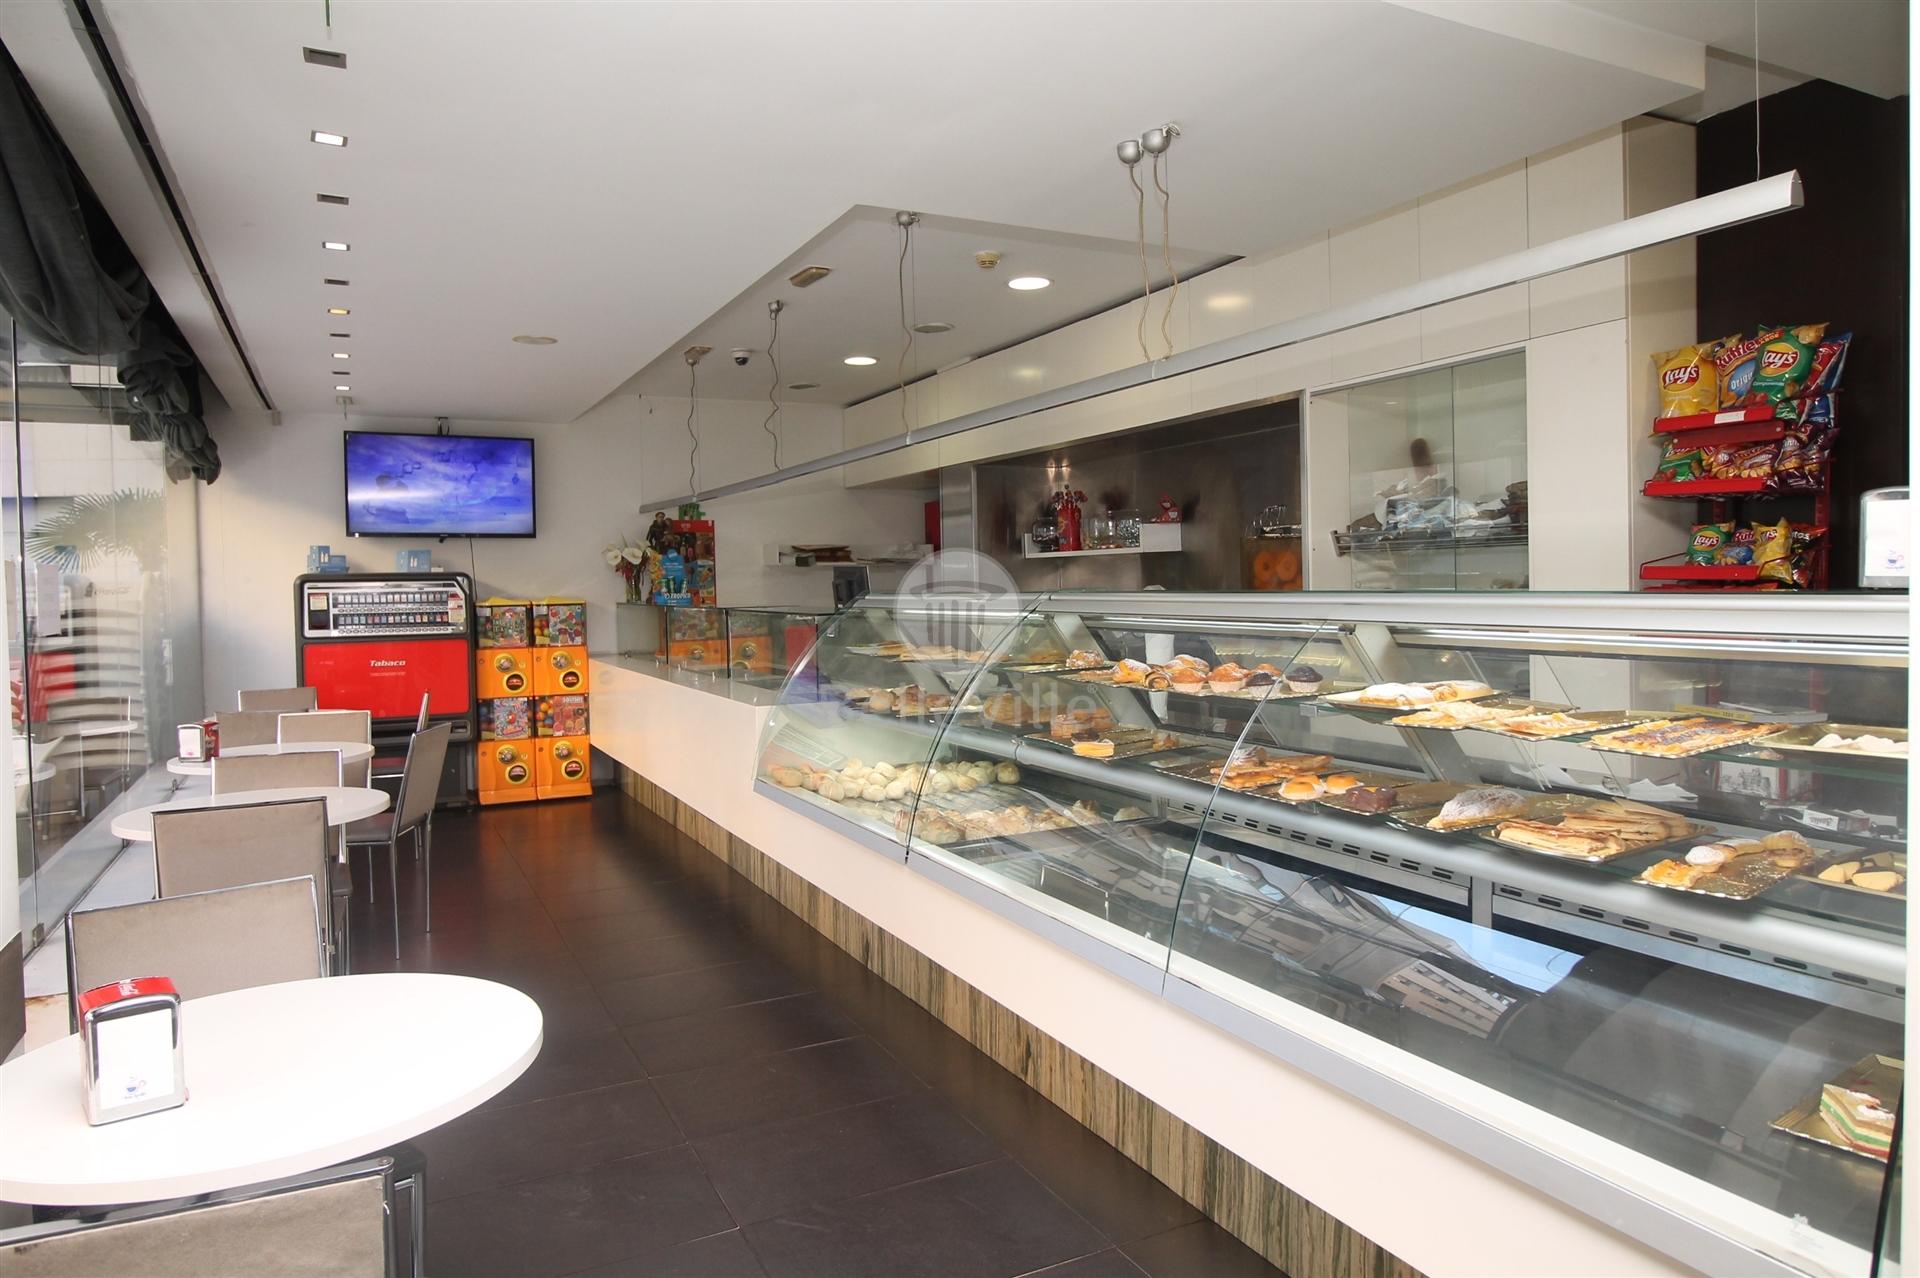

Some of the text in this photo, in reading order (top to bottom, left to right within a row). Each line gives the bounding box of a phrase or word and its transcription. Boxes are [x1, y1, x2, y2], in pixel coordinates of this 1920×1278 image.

[1761, 349, 1798, 368] Lay's
[1663, 367, 1699, 385] Lay's
[1693, 534, 1719, 547] Lay's
[369, 659, 407, 667] Tabaco
